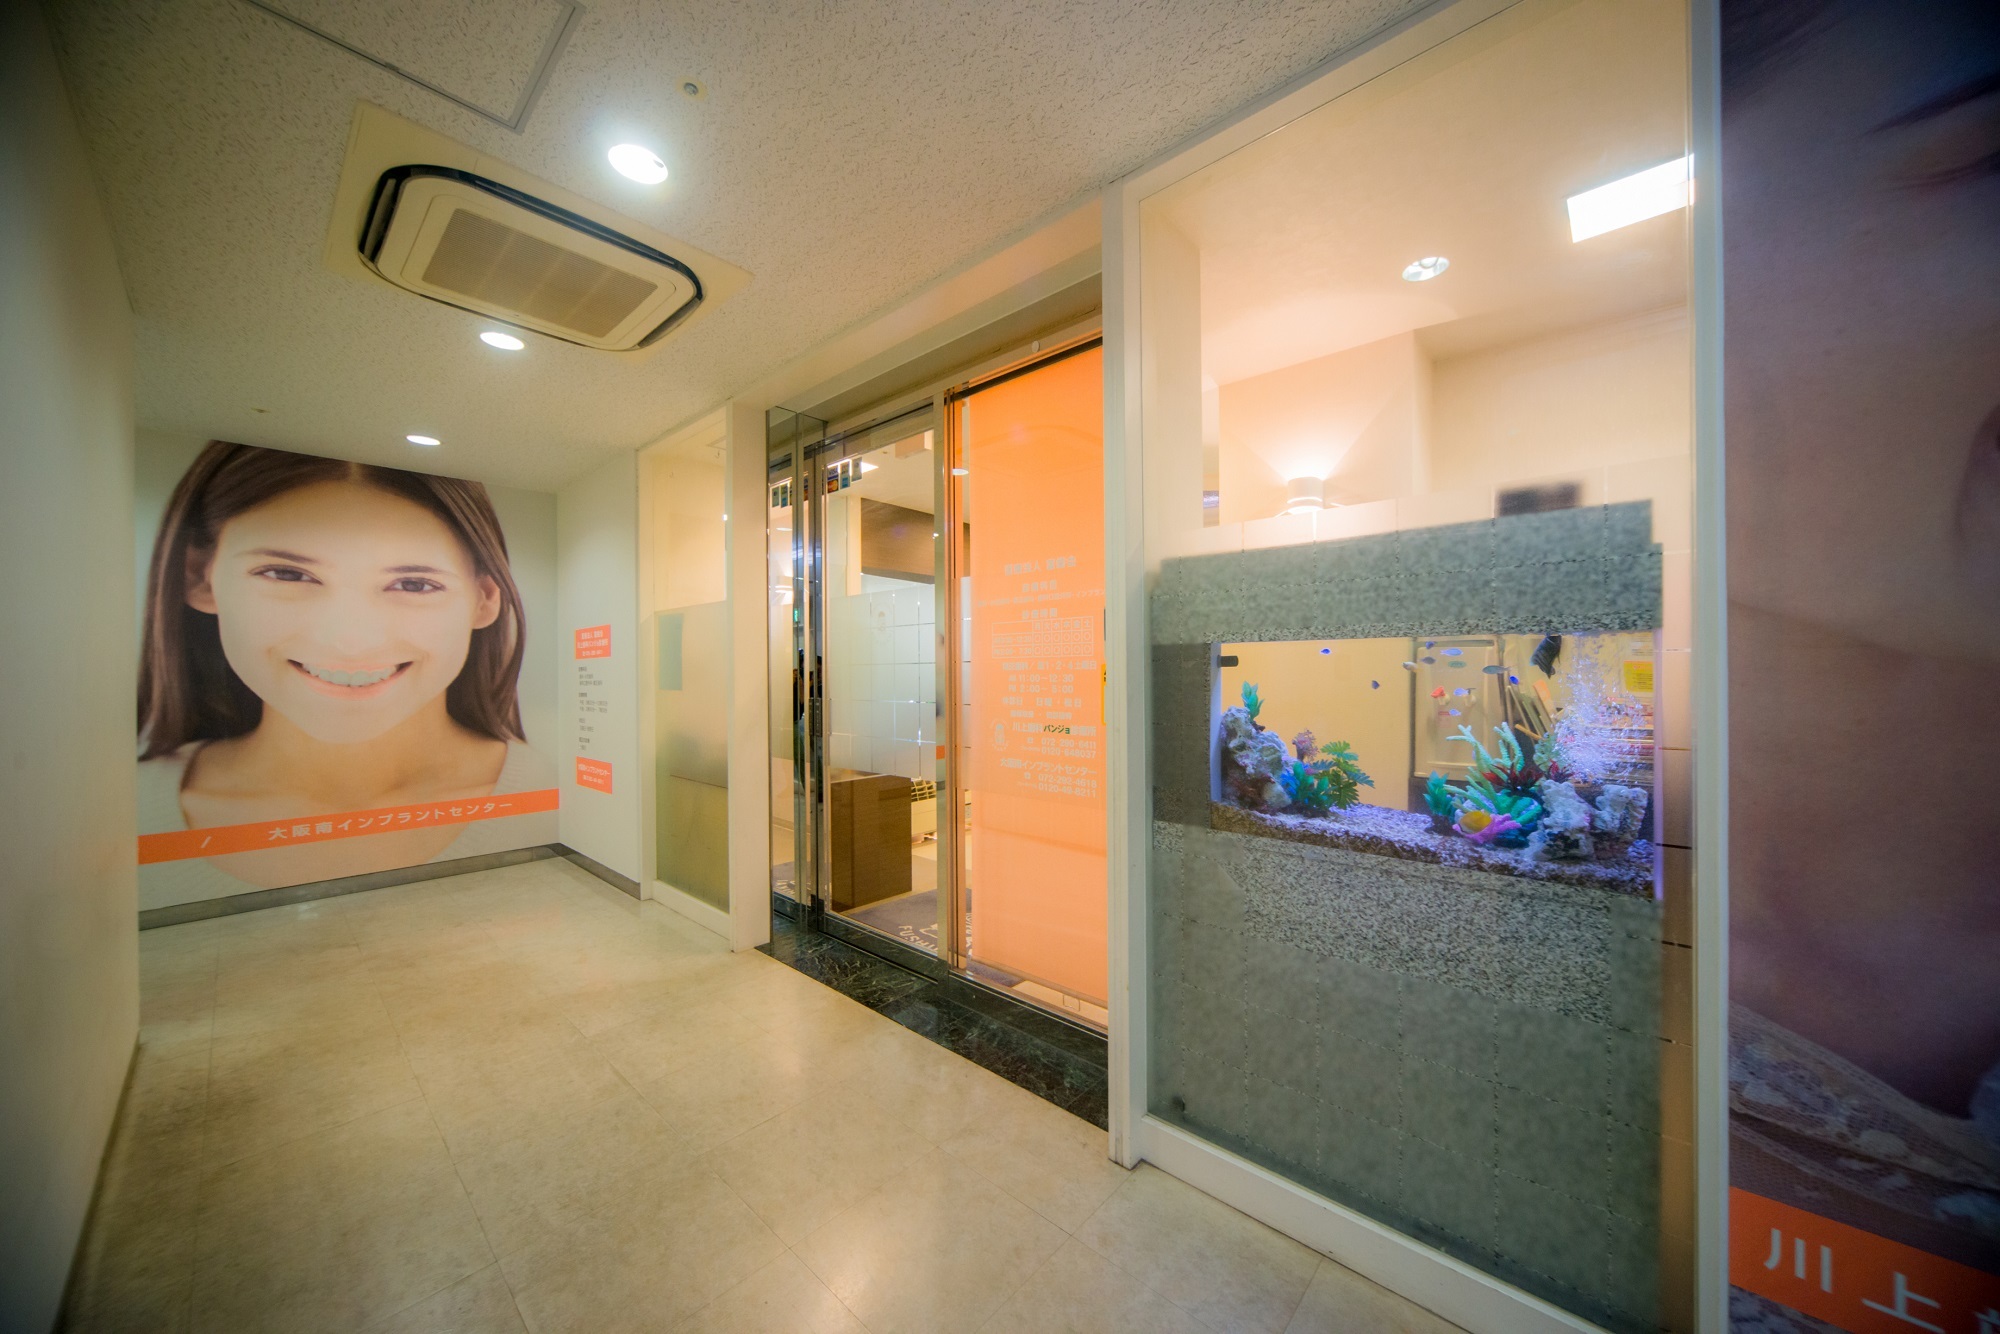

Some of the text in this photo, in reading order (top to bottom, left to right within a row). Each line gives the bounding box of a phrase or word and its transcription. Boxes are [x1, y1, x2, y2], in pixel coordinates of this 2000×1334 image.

[268, 801, 514, 841] 大阪南インプラントセンター
[1763, 1227, 2000, 1334] 川上
